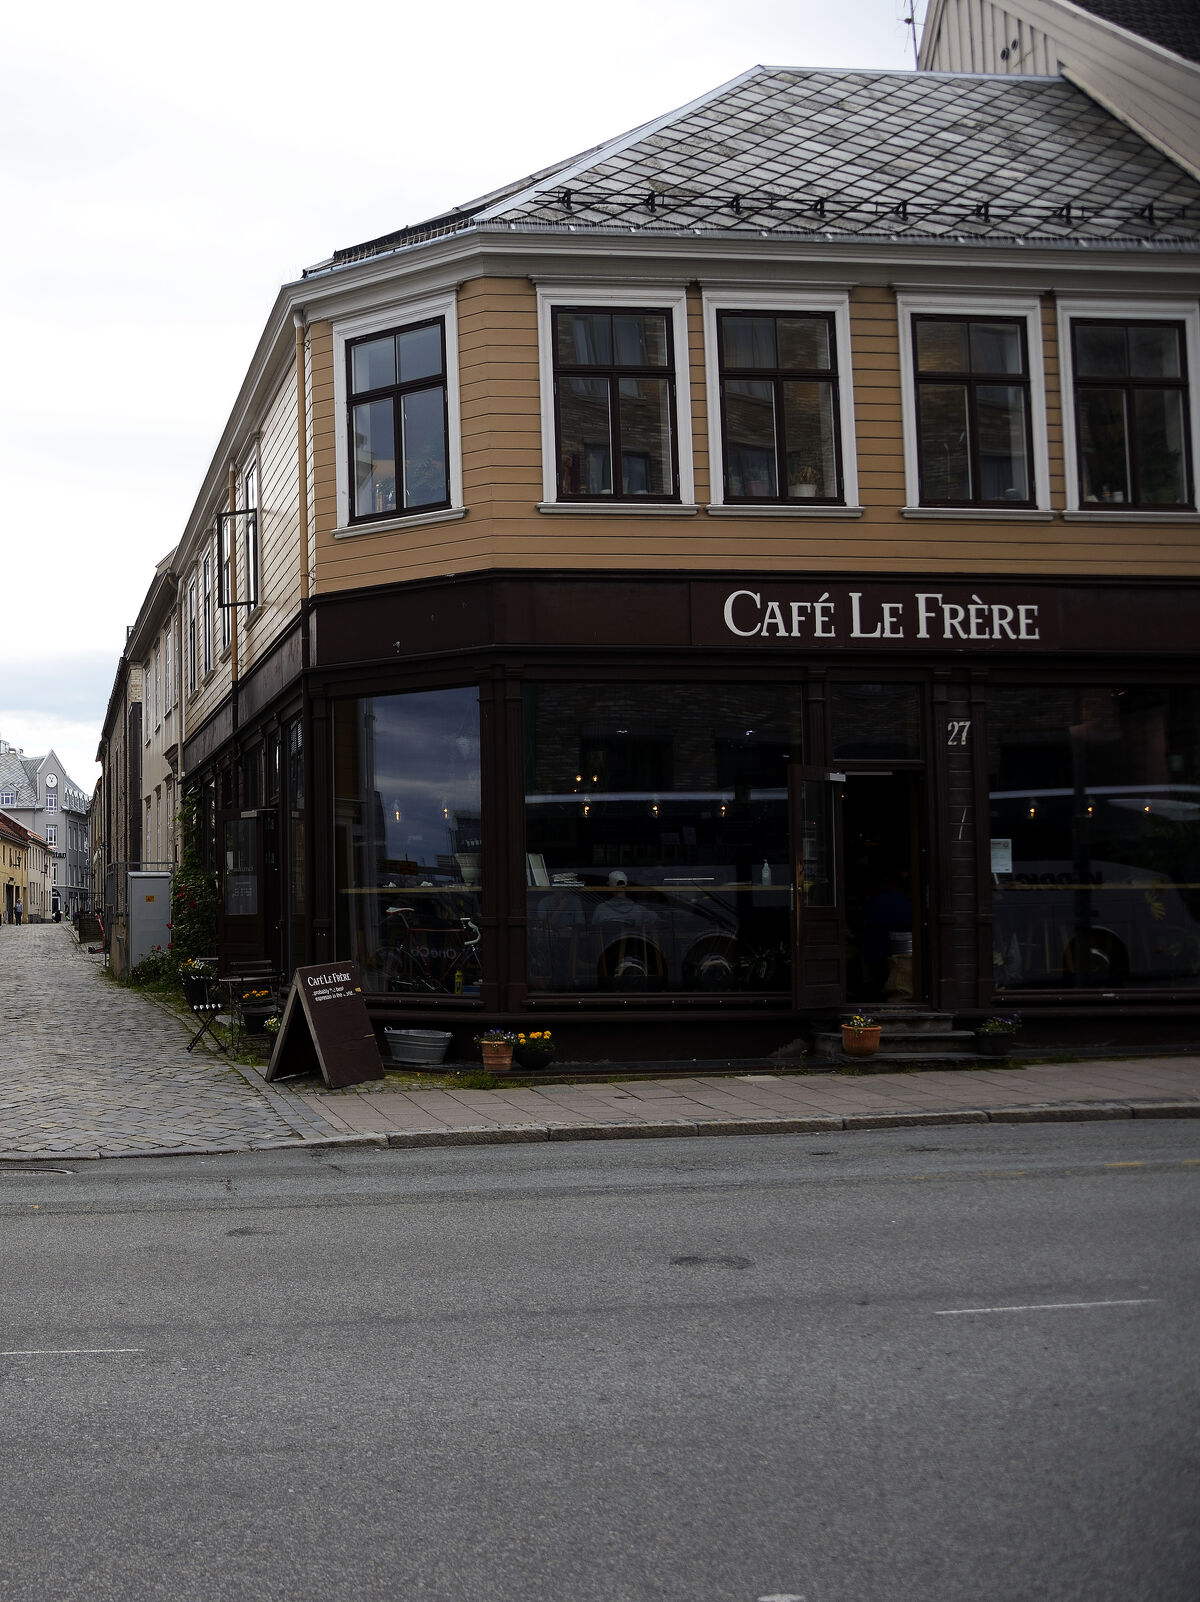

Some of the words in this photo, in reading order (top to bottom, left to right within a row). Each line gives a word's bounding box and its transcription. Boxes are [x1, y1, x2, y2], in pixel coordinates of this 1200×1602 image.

[723, 590, 836, 637] CAFÉ
[849, 592, 904, 639] LE
[915, 593, 1040, 640] FRÈRE
[947, 720, 971, 746] 27
[323, 974, 333, 984] LE
